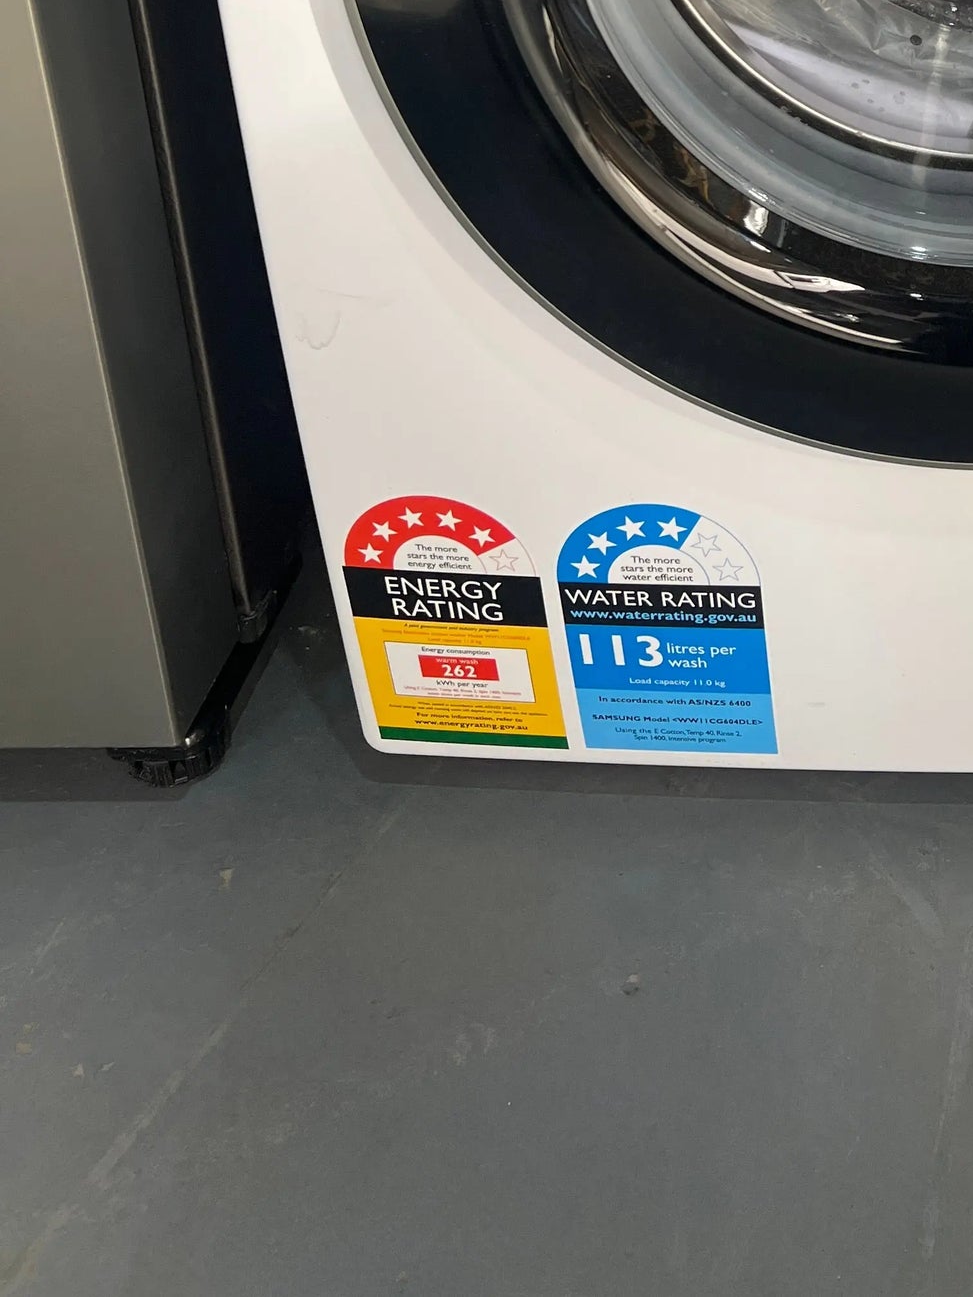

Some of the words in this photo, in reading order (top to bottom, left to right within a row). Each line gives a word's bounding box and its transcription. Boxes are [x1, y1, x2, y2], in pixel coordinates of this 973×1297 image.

[415, 543, 432, 552] The
[434, 545, 458, 553] more
[407, 552, 428, 560] stars
[430, 553, 445, 561] the
[631, 555, 650, 564] The
[407, 561, 436, 570] energy
[438, 562, 473, 570] efficient
[621, 565, 645, 573] stars
[647, 565, 664, 573] the
[623, 574, 651, 582] water
[655, 573, 693, 582] efficient
[384, 576, 502, 600] ENERGY
[564, 588, 653, 607] WATER
[661, 591, 756, 609] RATING
[391, 598, 504, 621] RATING
[570, 609, 757, 624] www.waterrating.gov.au
[421, 646, 445, 655] Energy
[446, 648, 491, 656] consumption
[579, 633, 664, 667] 113
[666, 642, 704, 655] litres
[710, 645, 736, 658] per
[435, 657, 458, 665] warm
[668, 657, 707, 668] wash
[441, 664, 478, 679] 262
[436, 679, 455, 687] kWh
[457, 681, 470, 689] per
[629, 677, 651, 685] Load
[654, 678, 690, 687] capacity
[714, 679, 726, 688] kg
[592, 714, 641, 722] SAMSUNG
[414, 719, 528, 731] www.energyrating.gov.au
